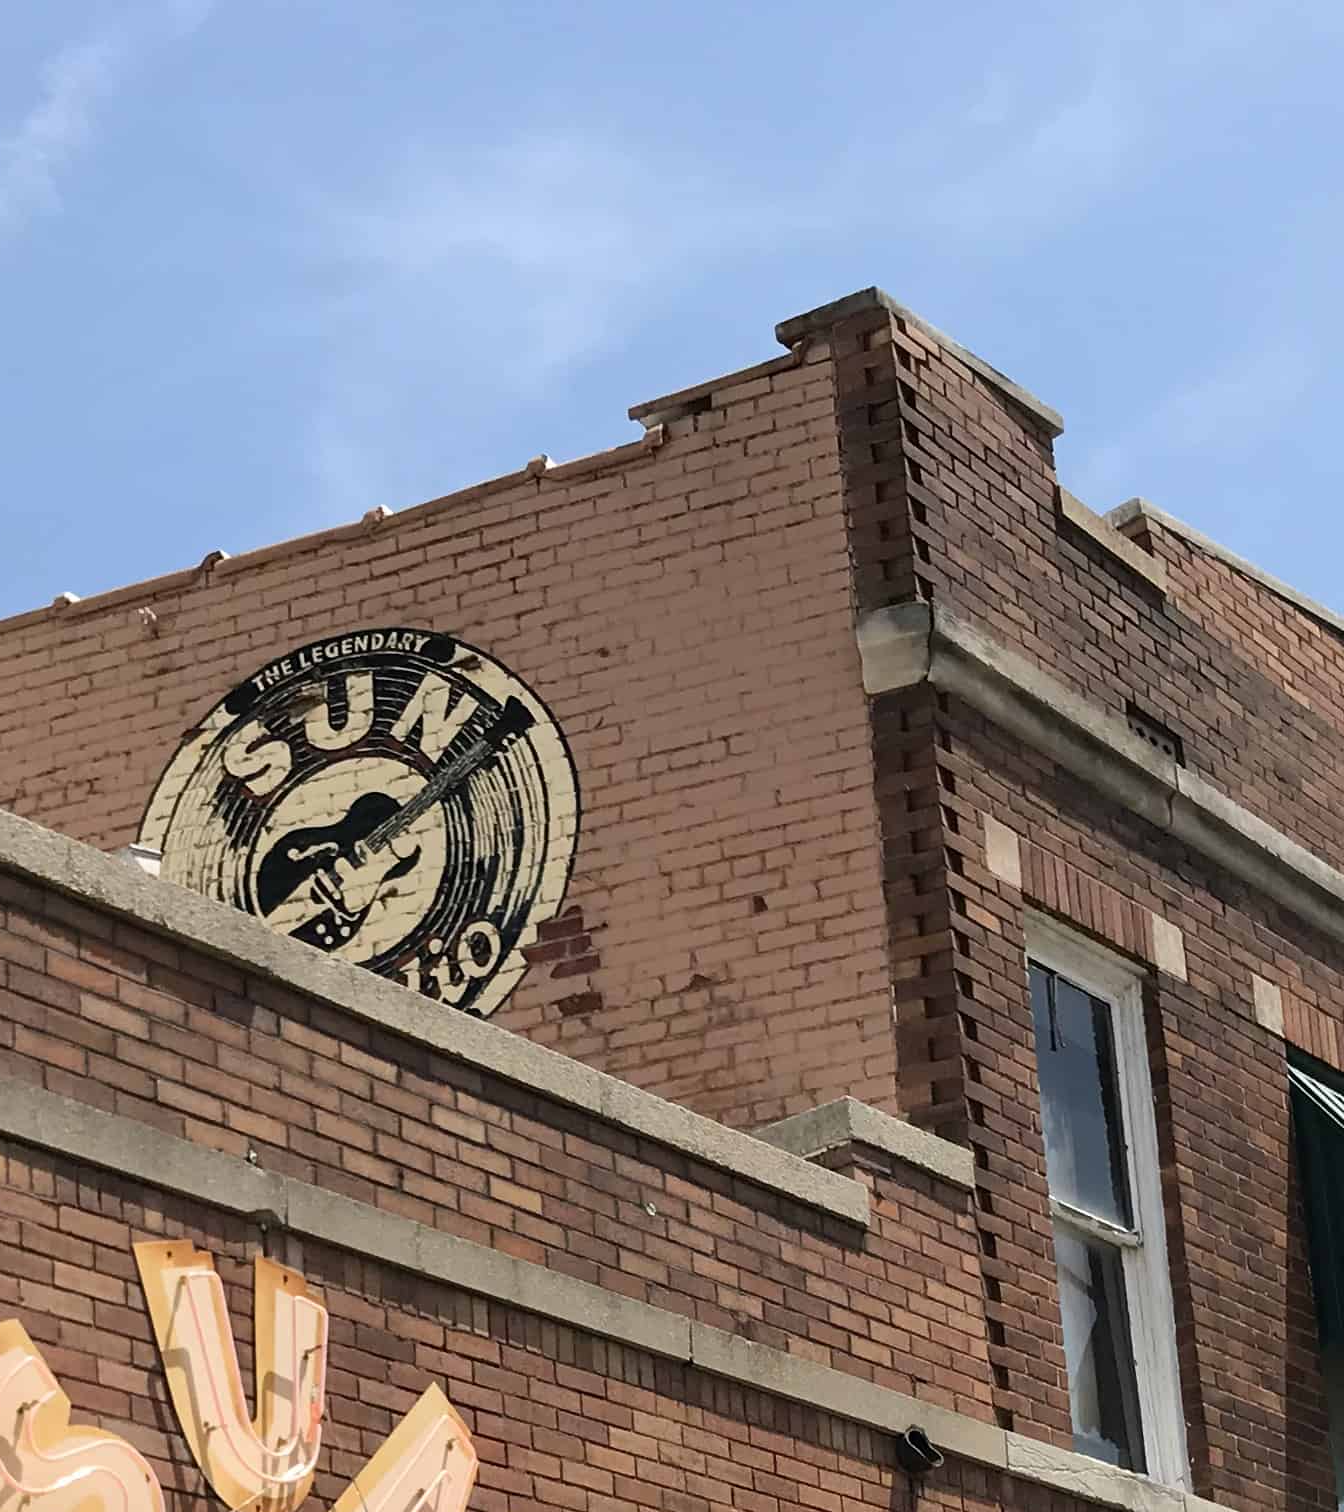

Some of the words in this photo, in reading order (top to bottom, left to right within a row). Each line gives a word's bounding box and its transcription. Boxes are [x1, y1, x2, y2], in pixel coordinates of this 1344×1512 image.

[251, 658, 294, 692] THE
[297, 631, 431, 669] LEGENDARY
[221, 670, 480, 797] SUN
